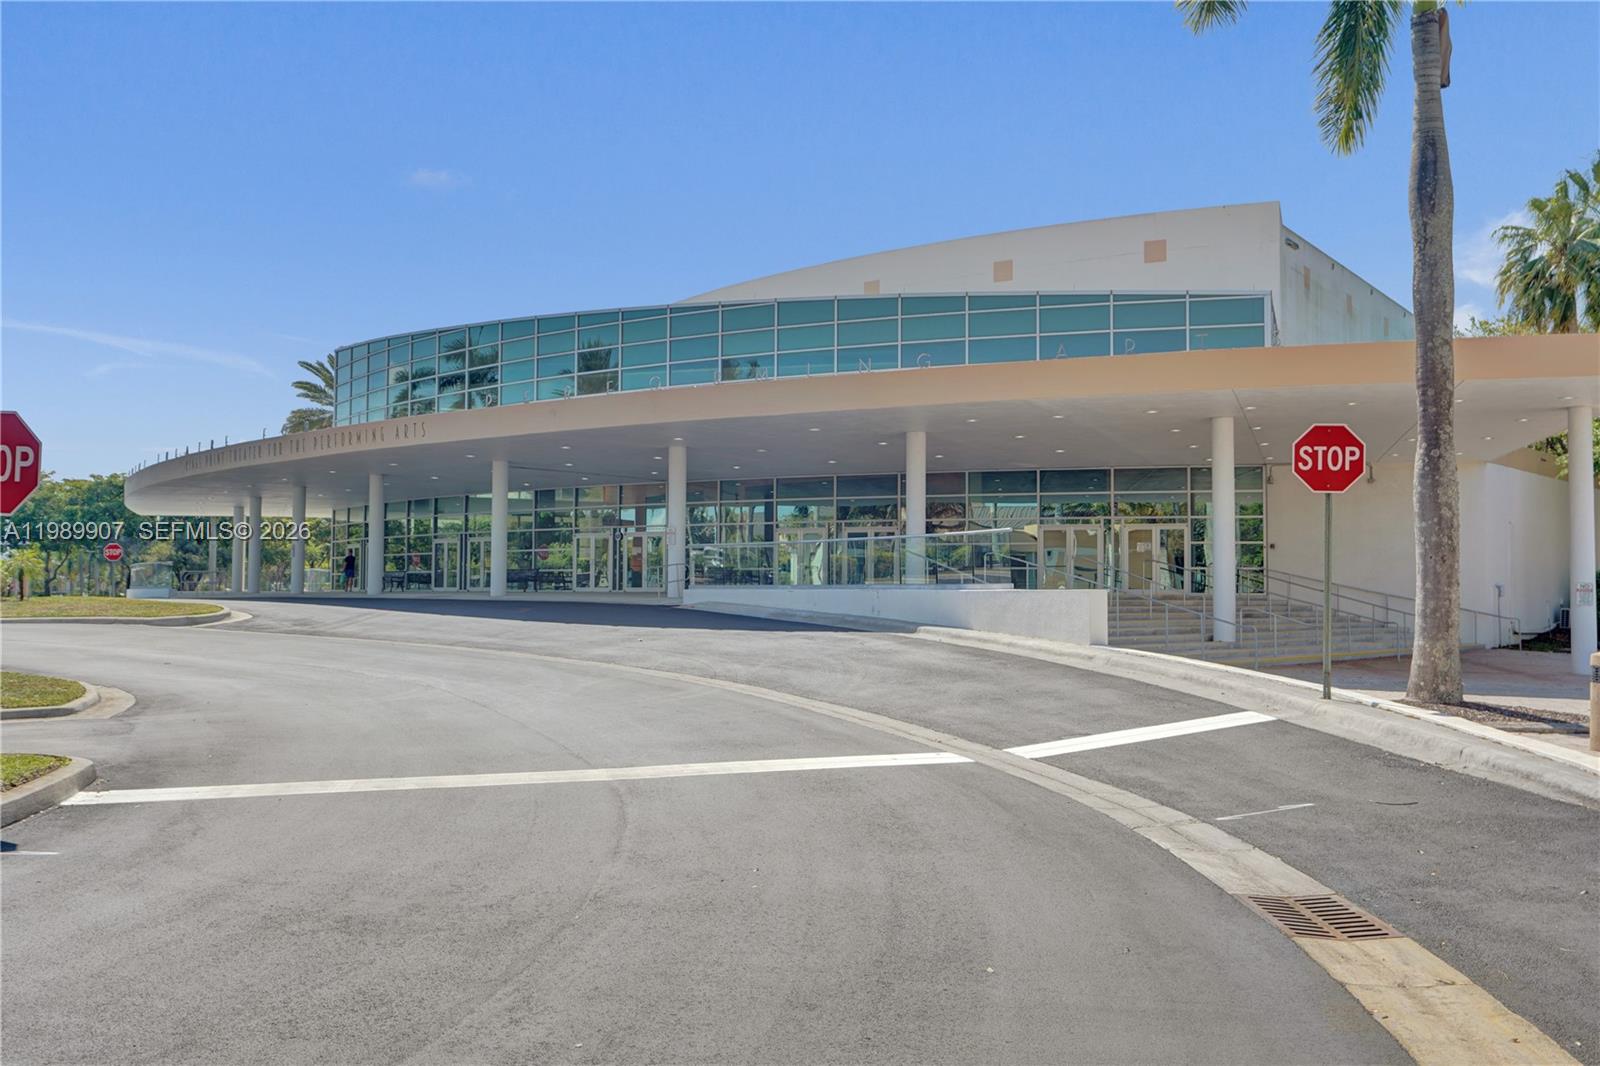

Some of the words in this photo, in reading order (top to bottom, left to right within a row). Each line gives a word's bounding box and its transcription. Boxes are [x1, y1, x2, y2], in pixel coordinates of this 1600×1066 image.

[313, 425, 385, 451] PERFORMING
[395, 421, 427, 441] ARTS
[0, 444, 34, 482] OP
[1298, 445, 1361, 471] STOP
[104, 548, 122, 557] STOP
